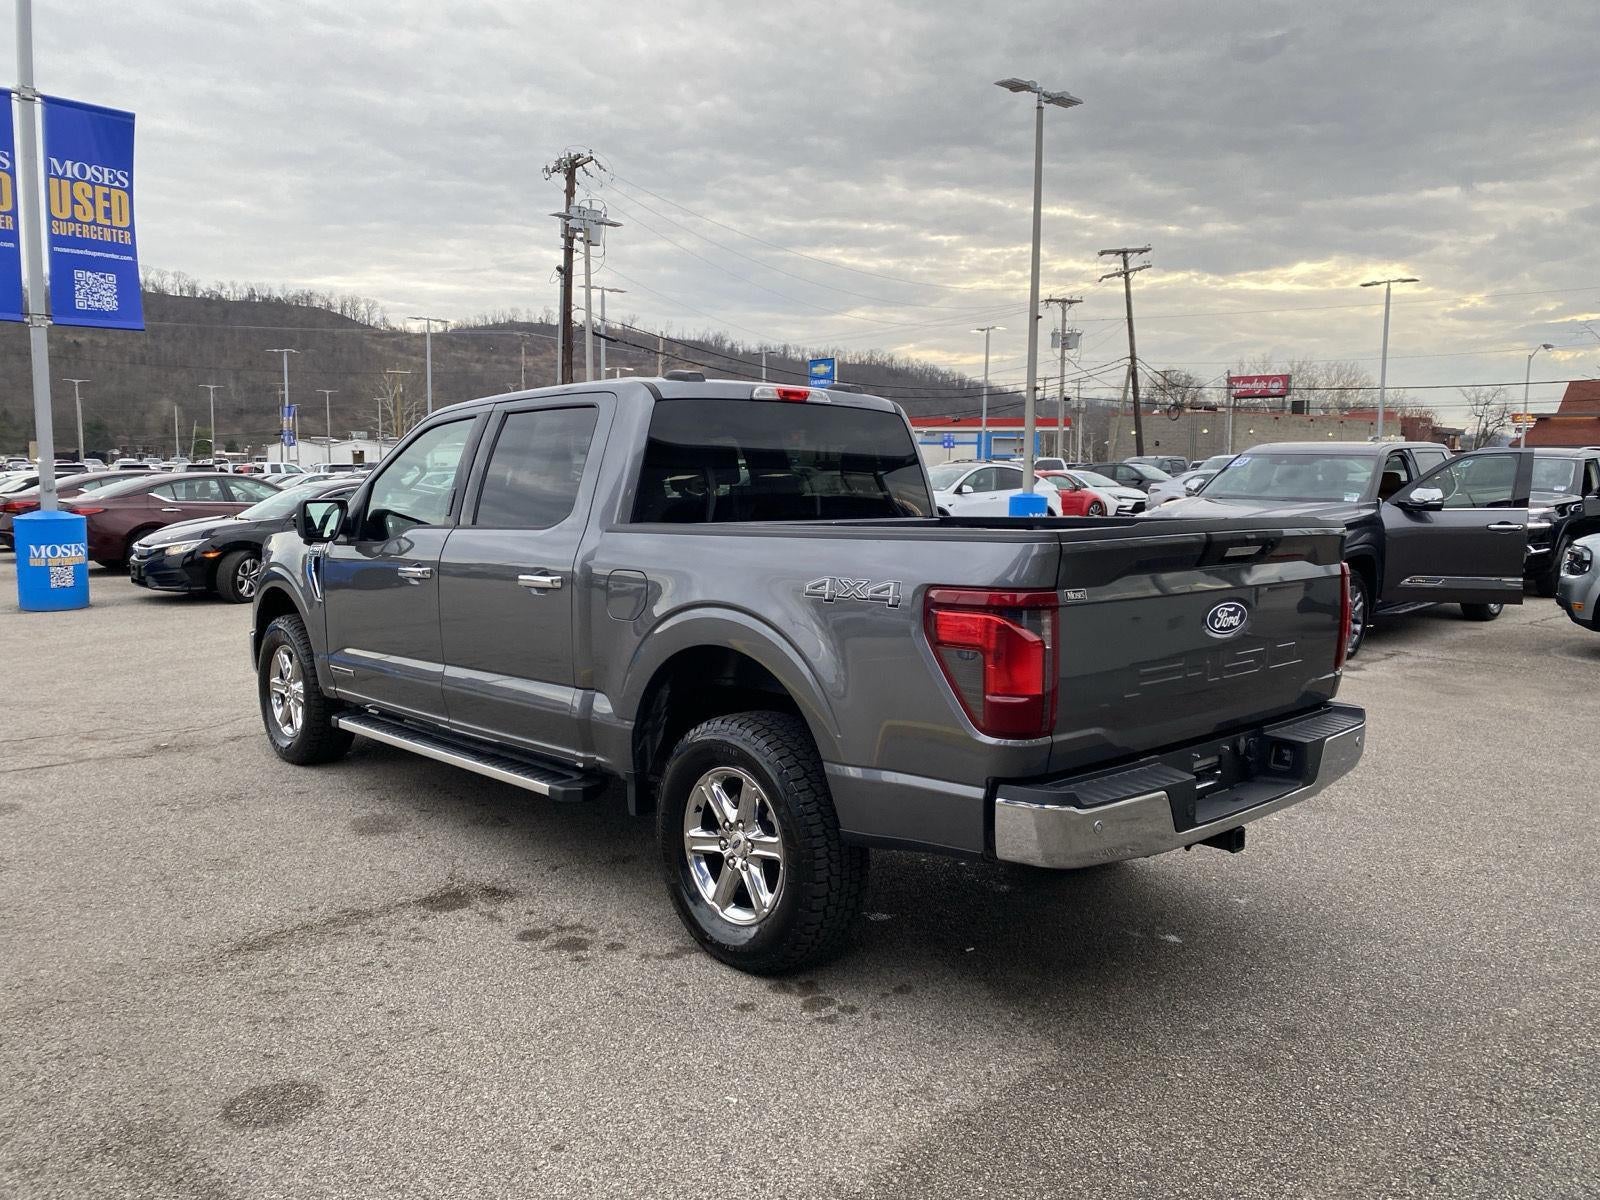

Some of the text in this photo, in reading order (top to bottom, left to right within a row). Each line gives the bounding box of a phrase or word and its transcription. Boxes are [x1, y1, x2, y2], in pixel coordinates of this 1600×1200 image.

[49, 157, 129, 188] MOSES
[49, 178, 130, 228] USED
[52, 219, 132, 245] SUPERCENTER
[29, 543, 86, 559] MOSES
[1214, 606, 1241, 629] Ford
